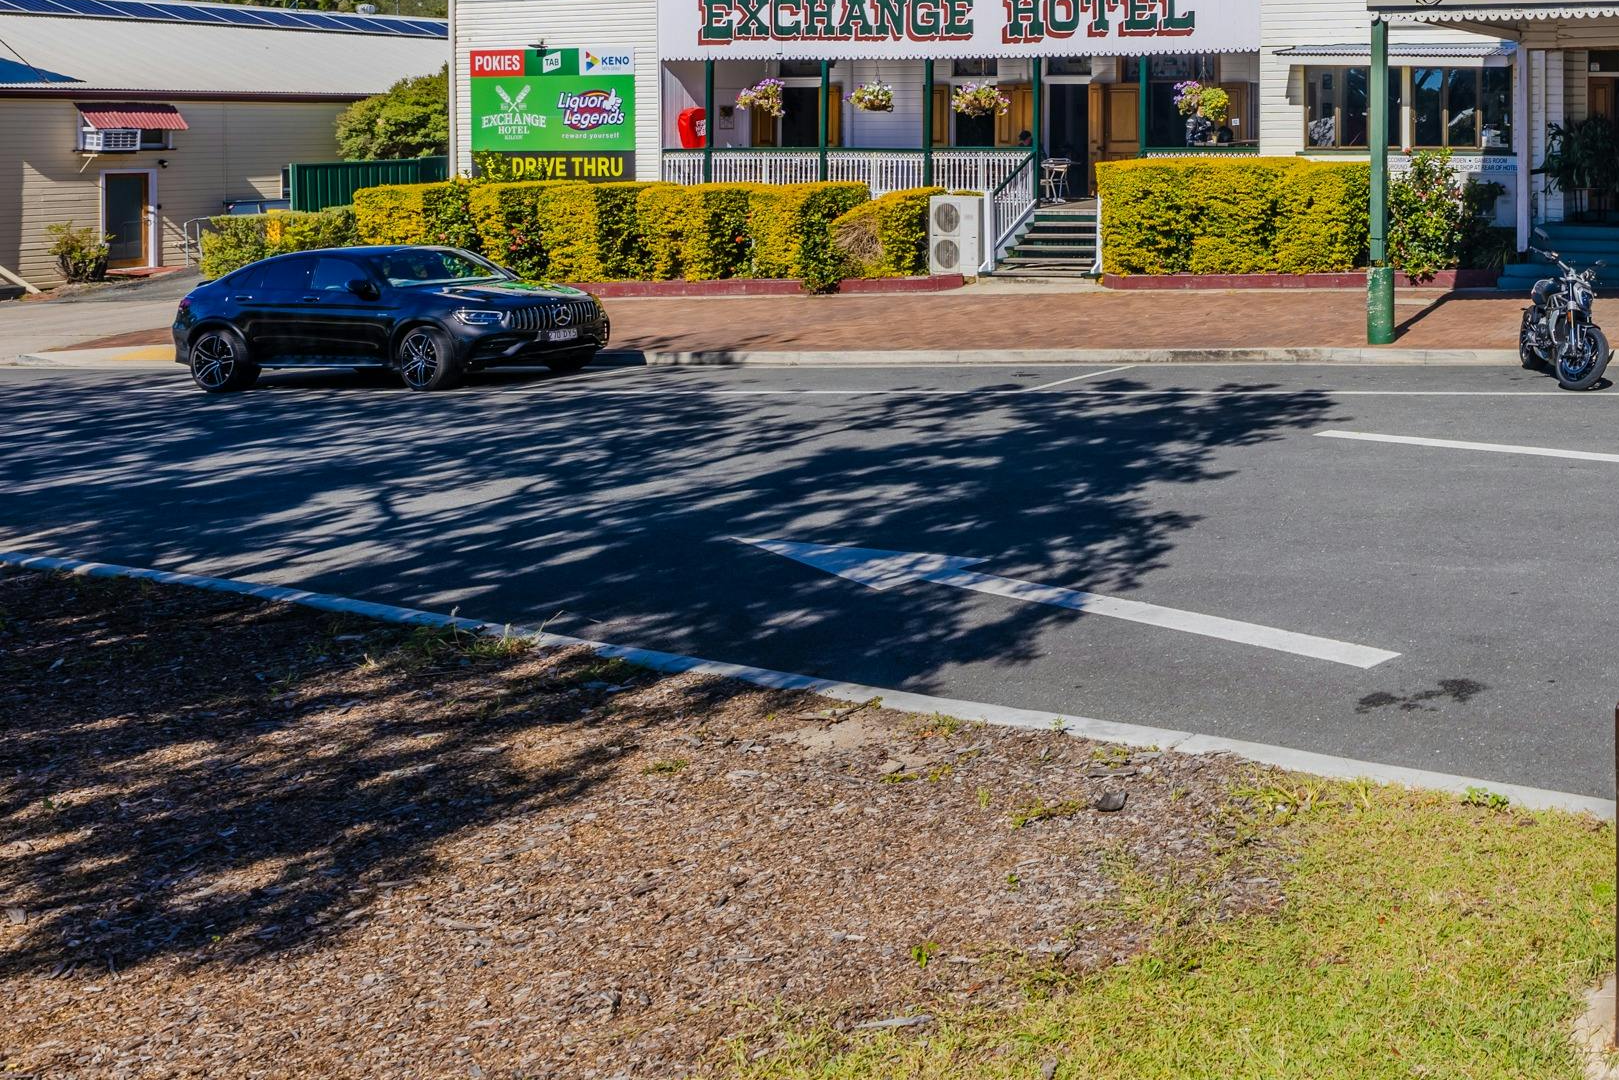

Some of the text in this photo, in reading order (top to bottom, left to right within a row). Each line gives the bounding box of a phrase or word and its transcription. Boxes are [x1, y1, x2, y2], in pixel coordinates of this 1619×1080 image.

[475, 54, 521, 71] POKIES
[544, 57, 560, 67] TAB
[601, 56, 630, 66] KENO
[557, 92, 605, 112] Liquor
[481, 112, 547, 129] EXCHANGE
[563, 109, 625, 129] Legends
[498, 125, 530, 135] HOTEL
[589, 131, 620, 140] yourself
[571, 156, 624, 177] THRU
